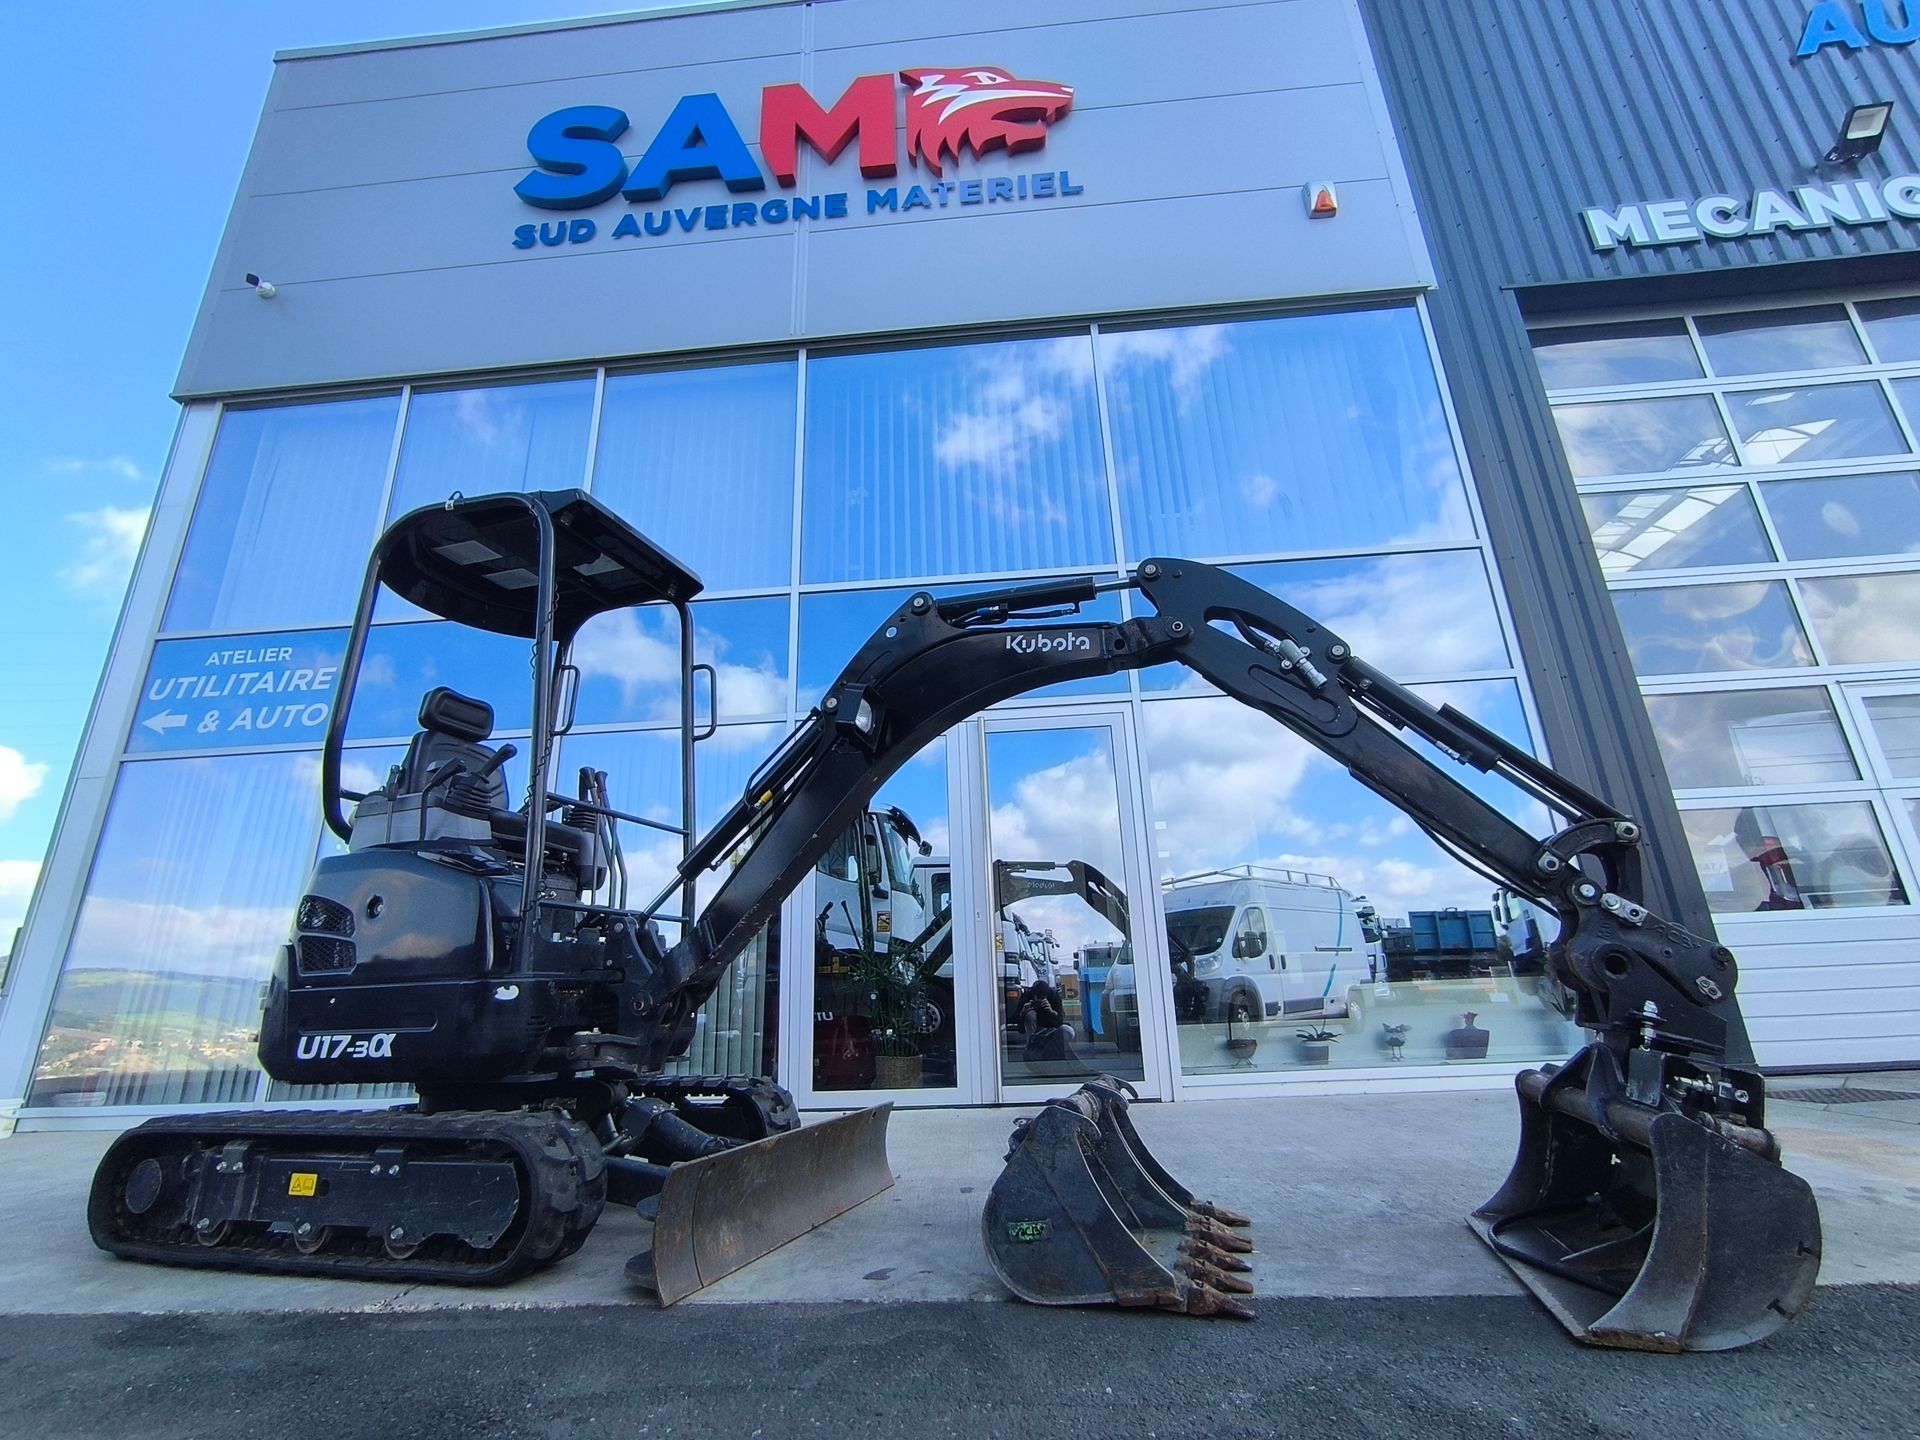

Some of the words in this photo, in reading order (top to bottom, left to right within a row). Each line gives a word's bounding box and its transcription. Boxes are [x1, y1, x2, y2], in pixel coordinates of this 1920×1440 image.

[513, 73, 897, 211] SAM
[512, 218, 597, 249] SUD
[612, 192, 848, 239] AUVERGNE
[866, 171, 1085, 214] MATERIEL
[204, 647, 293, 666] ATELIER
[1005, 631, 1090, 654] Kubota
[149, 666, 338, 701] UTILITAIRE
[196, 709, 220, 734] &
[227, 702, 329, 732] AUTO
